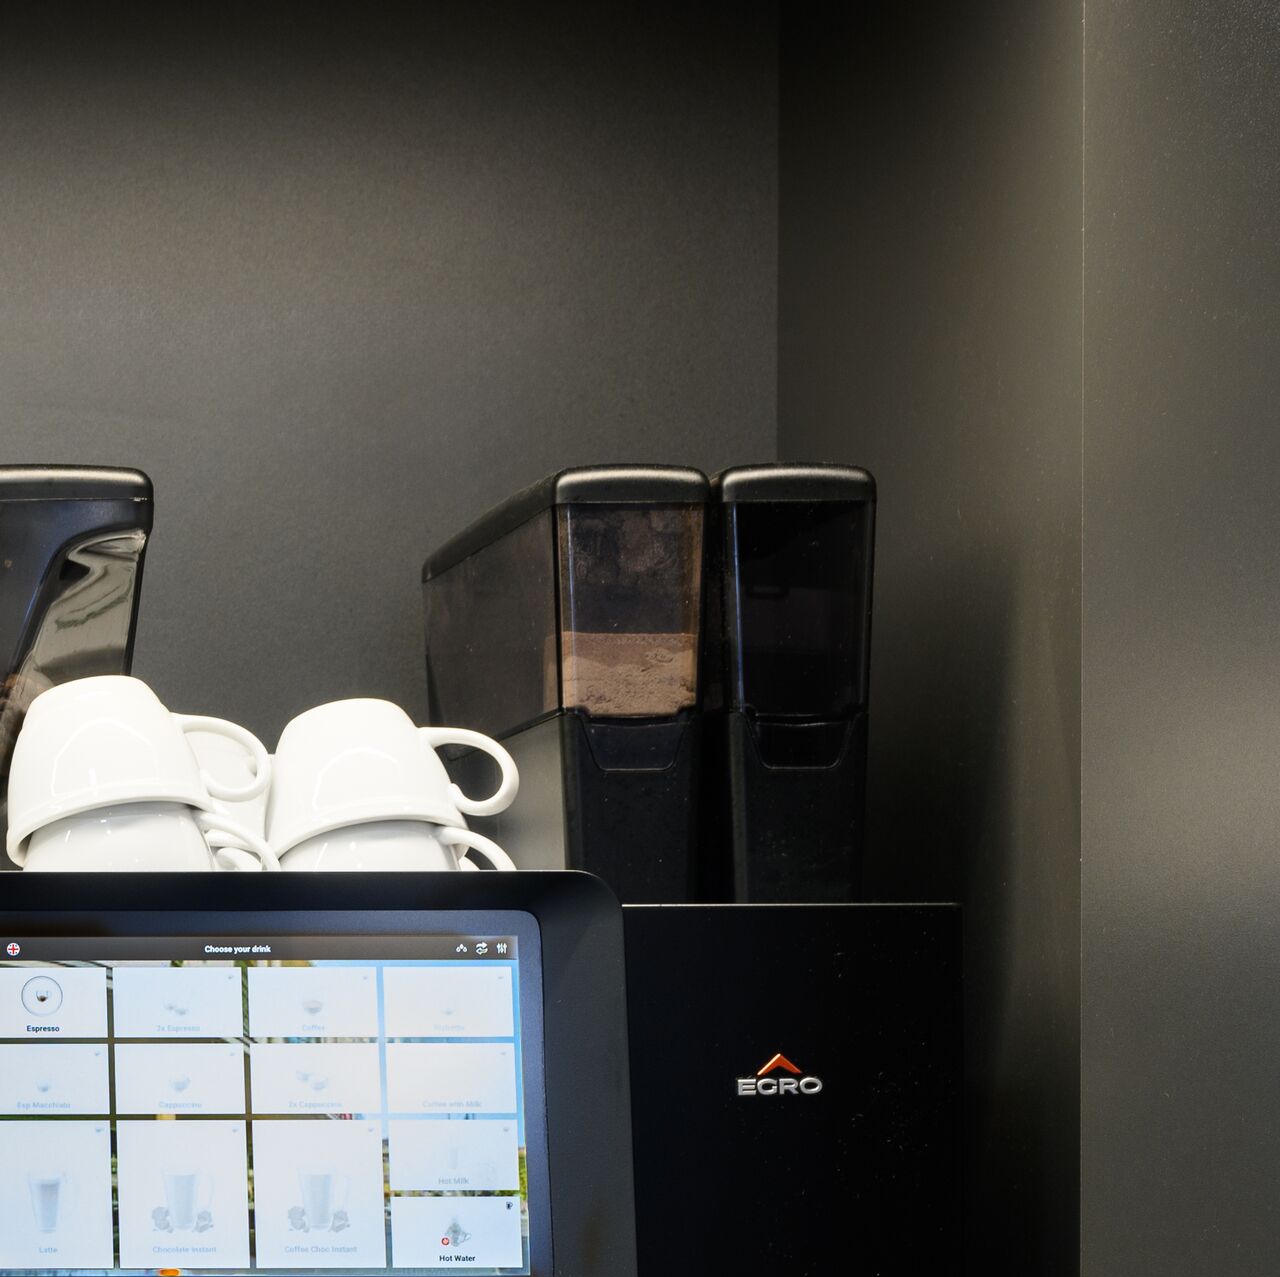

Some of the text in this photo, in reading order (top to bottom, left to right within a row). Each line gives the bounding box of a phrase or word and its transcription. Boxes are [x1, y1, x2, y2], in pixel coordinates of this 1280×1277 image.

[204, 945, 272, 955] Choose your drink
[26, 1024, 61, 1034] Espresso
[737, 1077, 823, 1096] EGRO
[158, 1101, 203, 1110] Cappuccino
[465, 1100, 482, 1108] Milk
[438, 1177, 469, 1185] Hot Milk
[38, 1246, 58, 1254] Latte
[284, 1246, 309, 1254] Coffee
[310, 1246, 330, 1254] Choc
[439, 1254, 476, 1263] Hot Water
